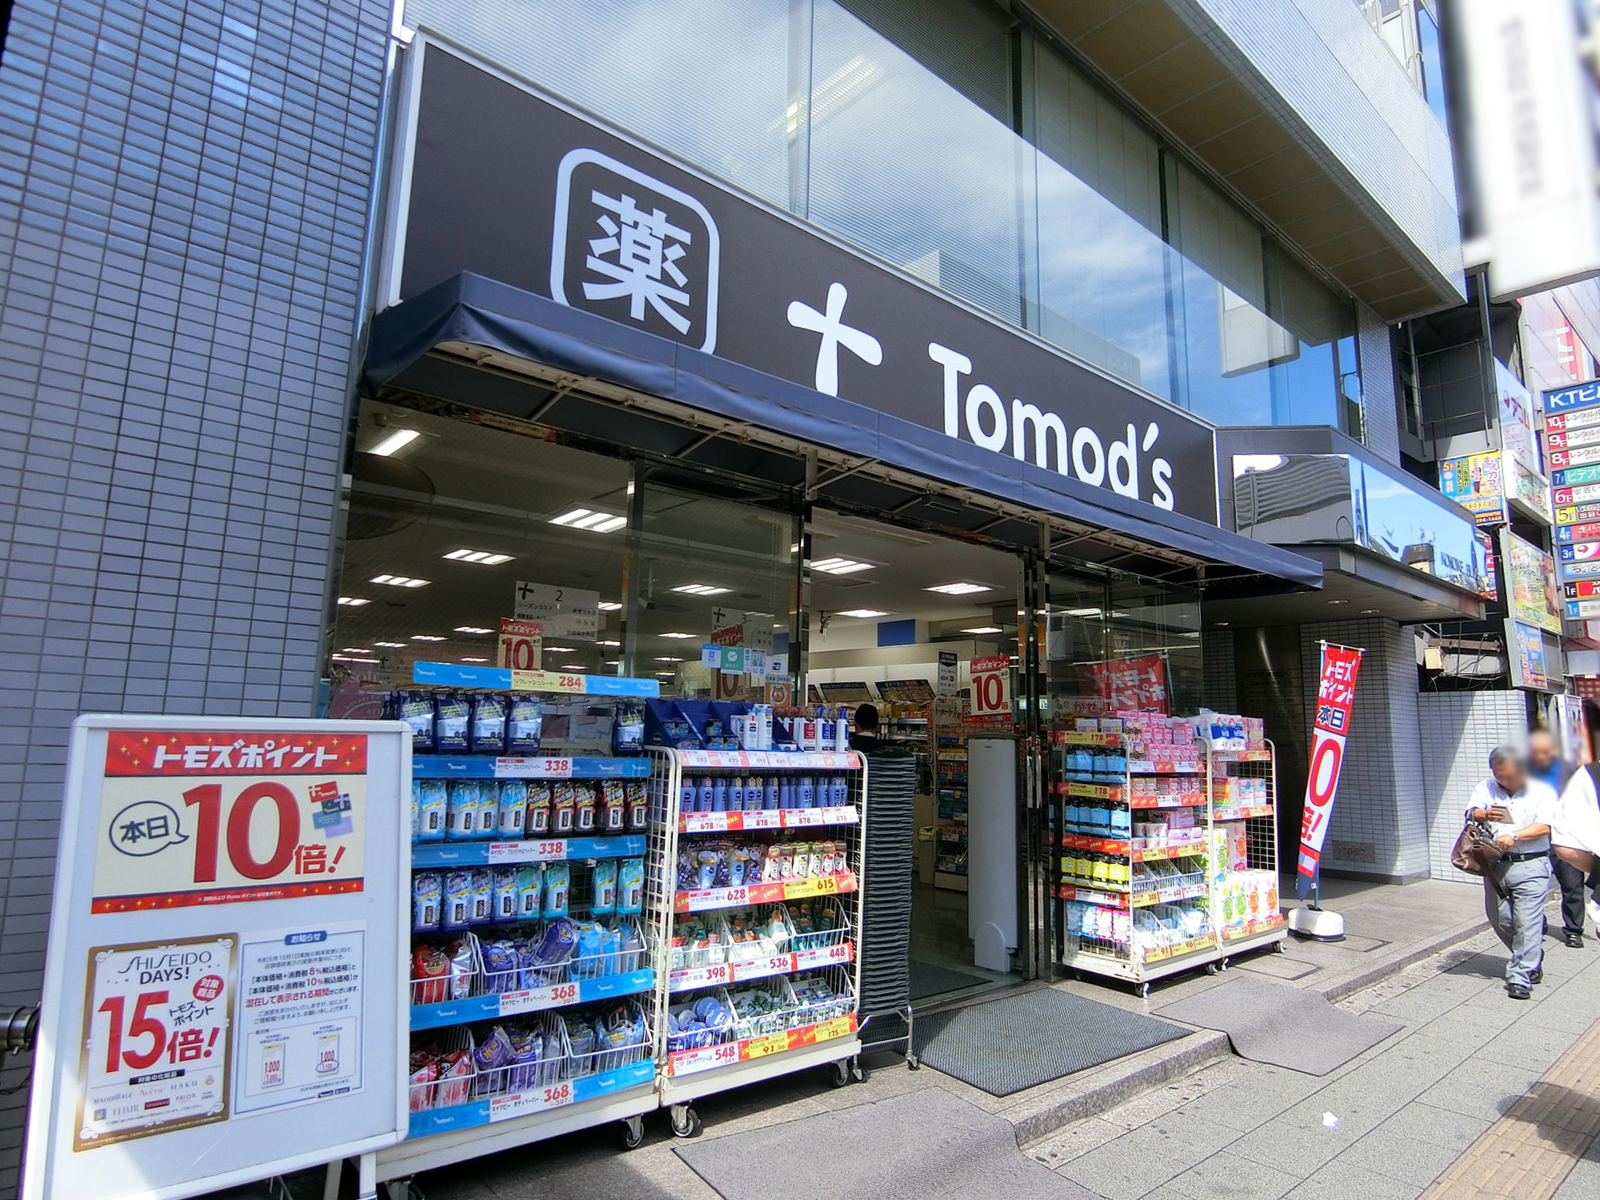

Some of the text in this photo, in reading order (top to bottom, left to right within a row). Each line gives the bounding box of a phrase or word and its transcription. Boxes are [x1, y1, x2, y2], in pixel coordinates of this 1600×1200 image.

[582, 190, 692, 336] 薬
[929, 341, 1177, 513] Tomod's
[1547, 416, 1566, 429] 10F
[1549, 435, 1567, 448] 9F
[1551, 453, 1570, 466] 8F
[1555, 473, 1566, 484] 7F
[1567, 466, 1600, 482] ビデオ
[1555, 490, 1573, 504] 6F
[1558, 508, 1575, 522] 5F
[1559, 527, 1571, 540] 4F
[1562, 549, 1574, 559] 3F
[555, 590, 563, 602] 2
[1565, 585, 1577, 597] 1F
[971, 661, 1009, 671] トモズポイント
[1325, 659, 1356, 682] トモズ
[559, 676, 582, 687] 284
[1319, 678, 1355, 705] ポイント
[1318, 706, 1345, 729] 本日
[153, 739, 338, 769] トモズポイント
[545, 760, 569, 772] 338
[119, 815, 170, 844] 本日
[700, 822, 714, 830] 678
[539, 842, 563, 855] 338
[817, 879, 834, 890] 615
[727, 889, 746, 901] 628
[829, 947, 846, 958] 448
[117, 950, 212, 974] SHISEIDO
[770, 957, 788, 969] 536
[140, 966, 190, 985] DAYS!
[706, 966, 726, 980] 398
[551, 984, 576, 1001] 368
[174, 1006, 215, 1027] ポイント
[715, 1046, 735, 1060] 548
[543, 1084, 570, 1102] 368
